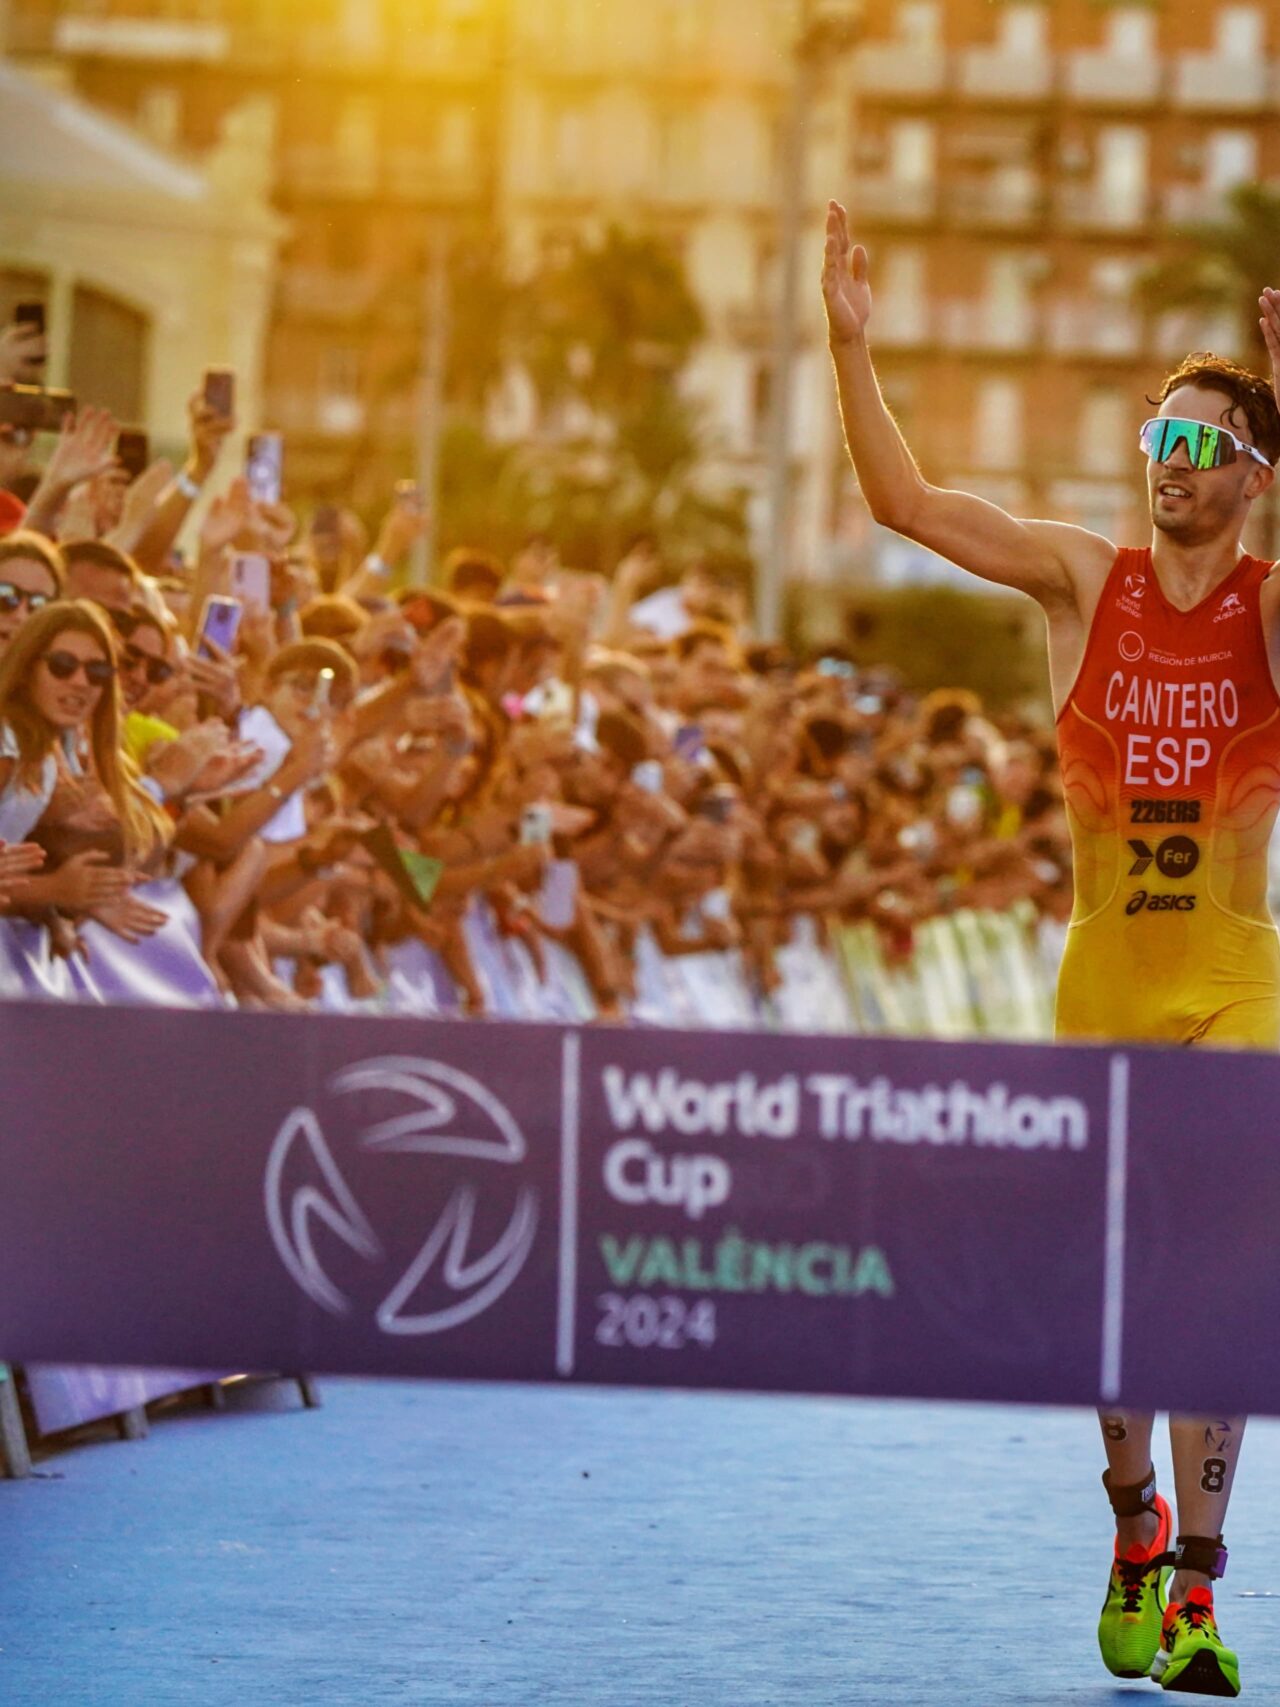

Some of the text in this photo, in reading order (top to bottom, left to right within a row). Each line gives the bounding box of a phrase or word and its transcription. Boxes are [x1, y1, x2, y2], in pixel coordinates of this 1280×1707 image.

[1184, 657, 1197, 666] DE
[1198, 650, 1232, 664] MURCIA
[1104, 670, 1239, 729] CANTERO
[1124, 733, 1211, 786] ESP
[1130, 799, 1201, 823] 226ERS
[1163, 849, 1192, 865] Fer
[1147, 894, 1197, 912] asics
[602, 1064, 1088, 1151] World Triathlon
[602, 1137, 732, 1221] Cup
[595, 1291, 717, 1350] 2024
[1201, 1457, 1227, 1494] 8
